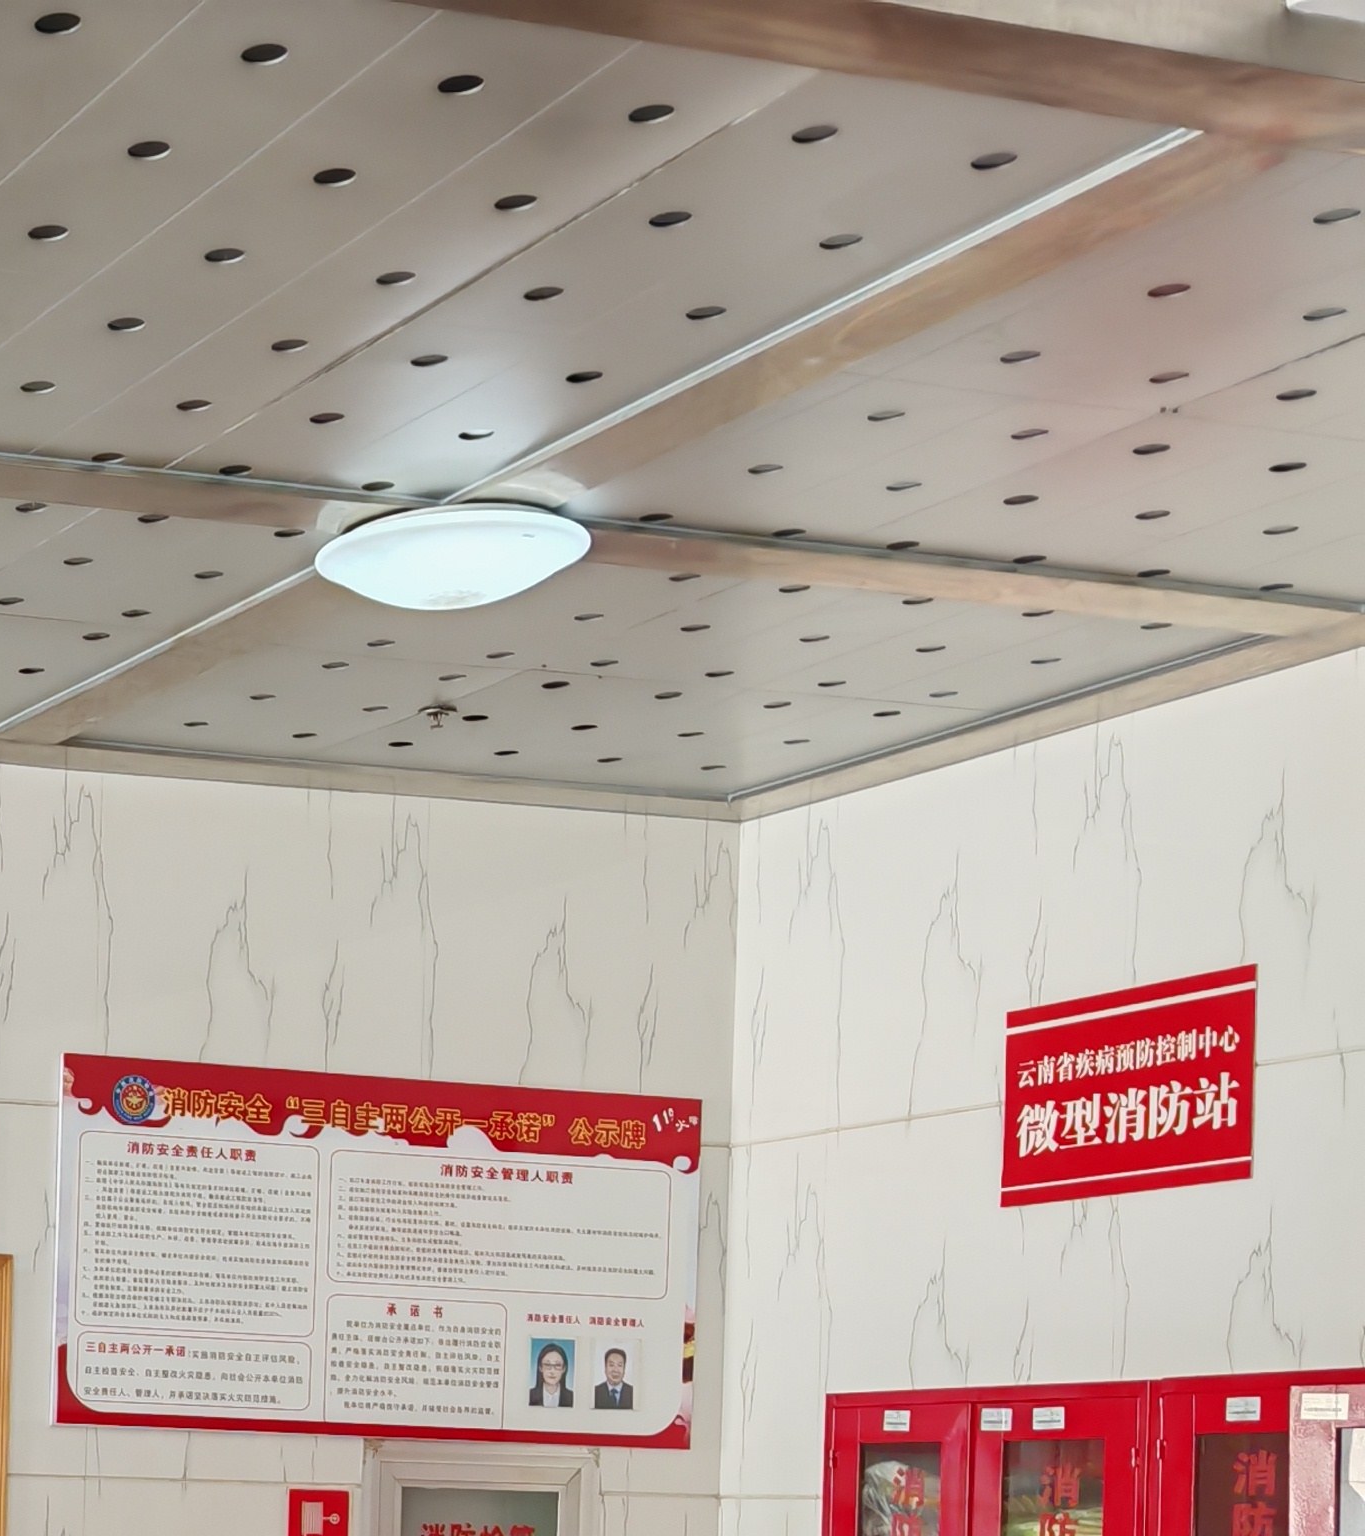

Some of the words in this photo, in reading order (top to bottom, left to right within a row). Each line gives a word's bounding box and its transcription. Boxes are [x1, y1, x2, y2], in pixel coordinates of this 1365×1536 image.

[1017, 1025, 1240, 1088] 云南省疾病预防控制中心
[163, 1087, 272, 1123] 消防安全
[568, 1117, 646, 1149] 公示牌
[1017, 1072, 1239, 1158] 微型消防站
[127, 1141, 257, 1162] 消防安全责任人职责
[440, 1163, 574, 1185] 消防安全管理人职责
